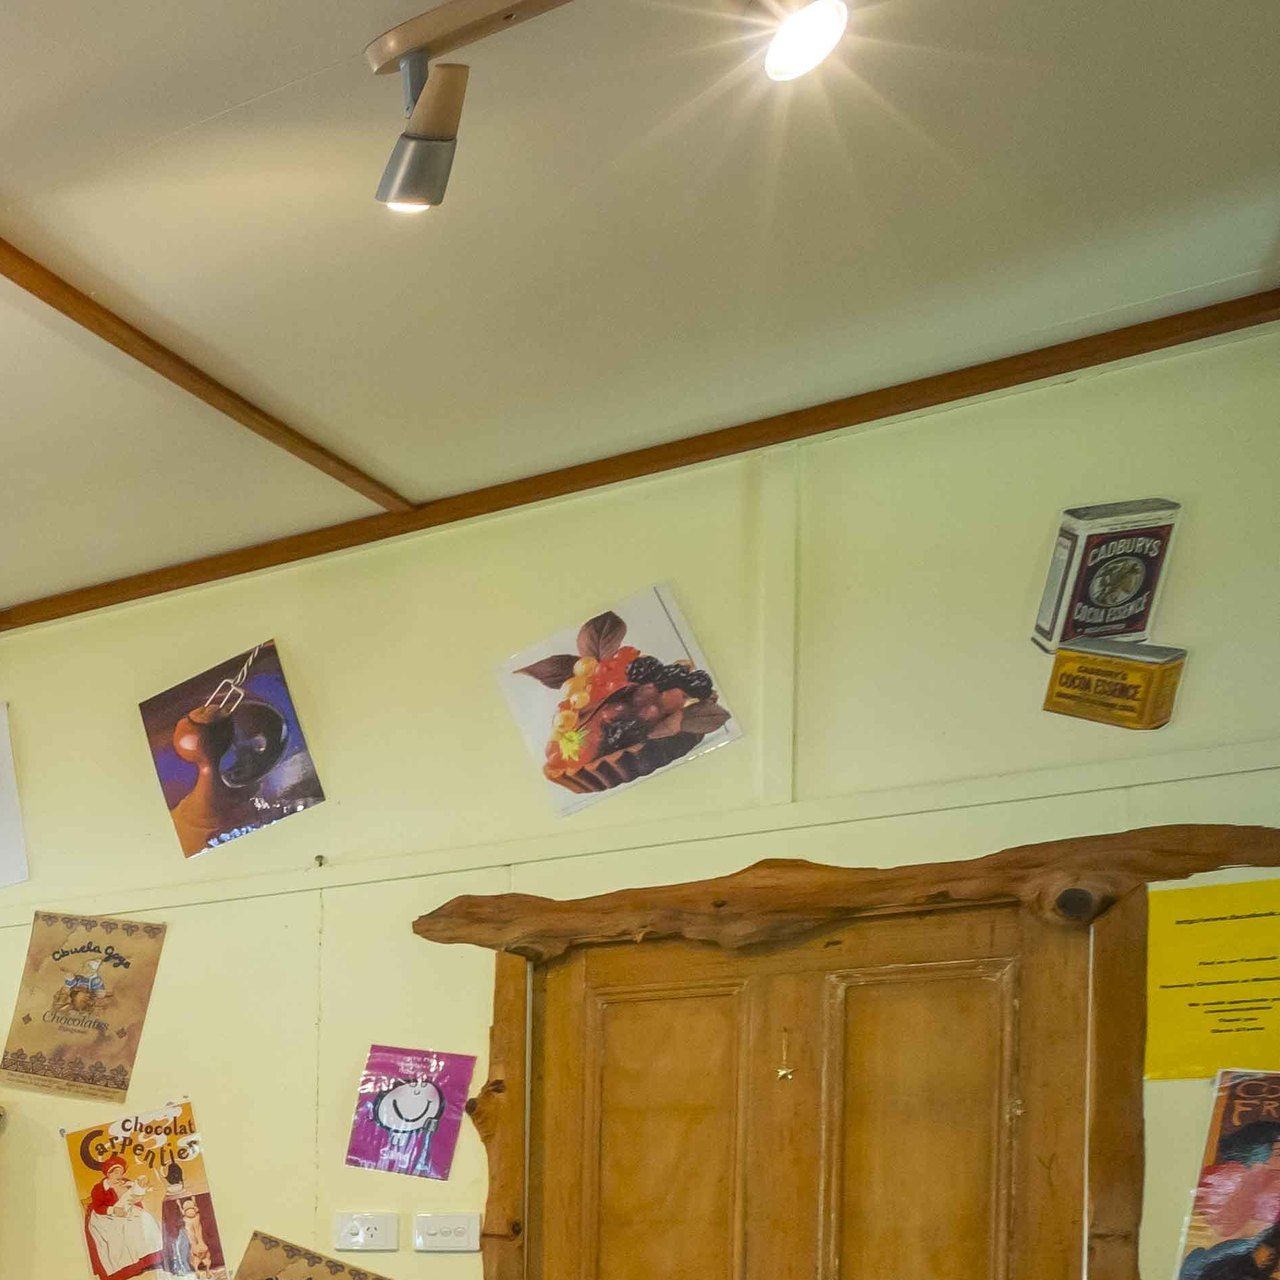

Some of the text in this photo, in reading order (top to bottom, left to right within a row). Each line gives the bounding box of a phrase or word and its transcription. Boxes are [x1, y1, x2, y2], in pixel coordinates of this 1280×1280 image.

[1074, 592, 1151, 623] COCOA ESSENCE
[1059, 673, 1142, 701] COCOA ESSENCE
[80, 1129, 199, 1171] Carpentier
